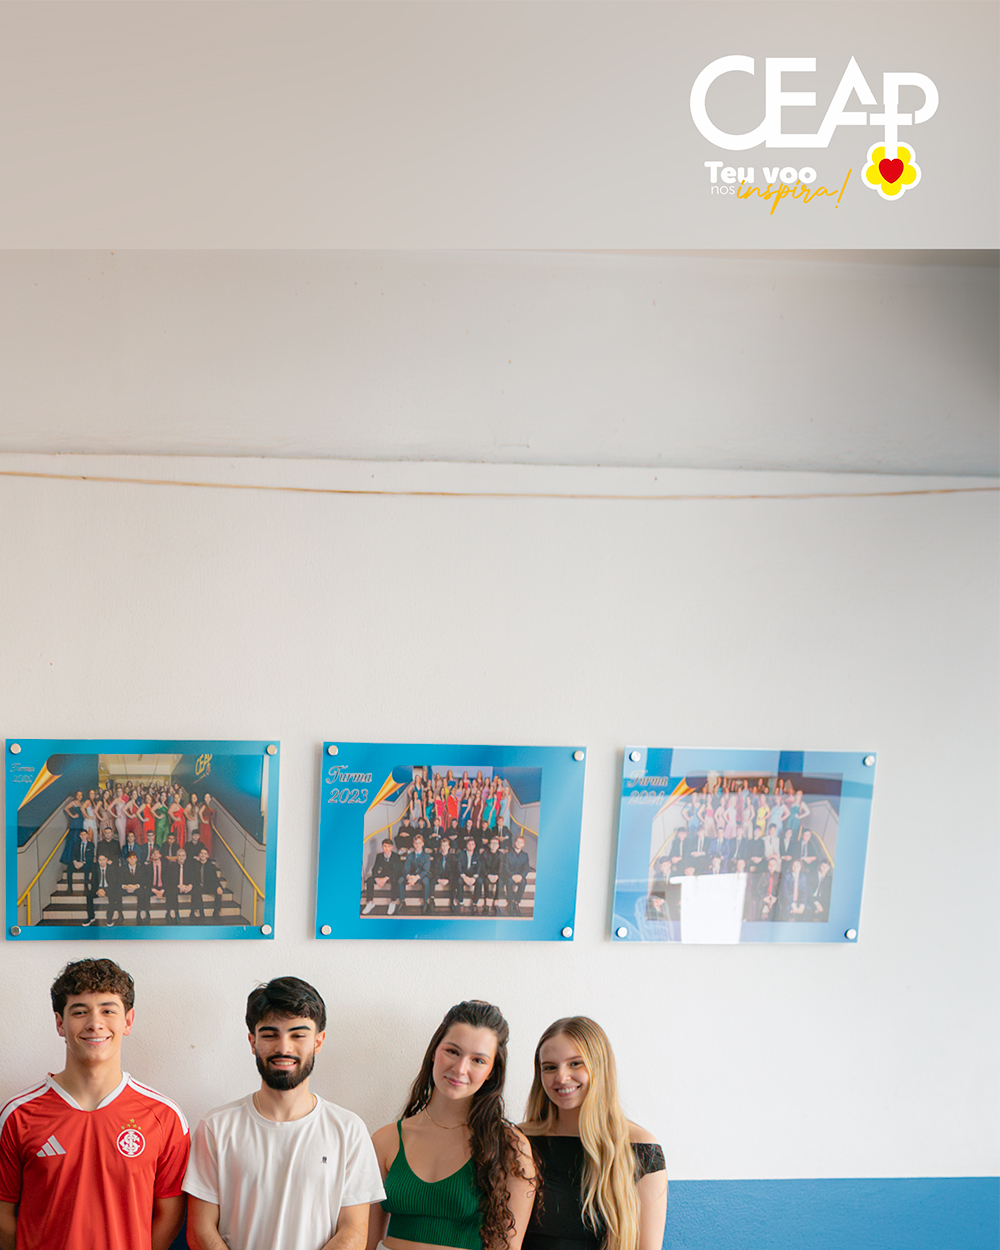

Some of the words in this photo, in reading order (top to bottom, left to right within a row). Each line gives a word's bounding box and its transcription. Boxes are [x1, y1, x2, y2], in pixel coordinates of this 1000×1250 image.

[326, 765, 372, 784] Turma
[627, 769, 668, 788] Turma
[327, 788, 369, 804] 2023
[628, 789, 666, 805] 2024
